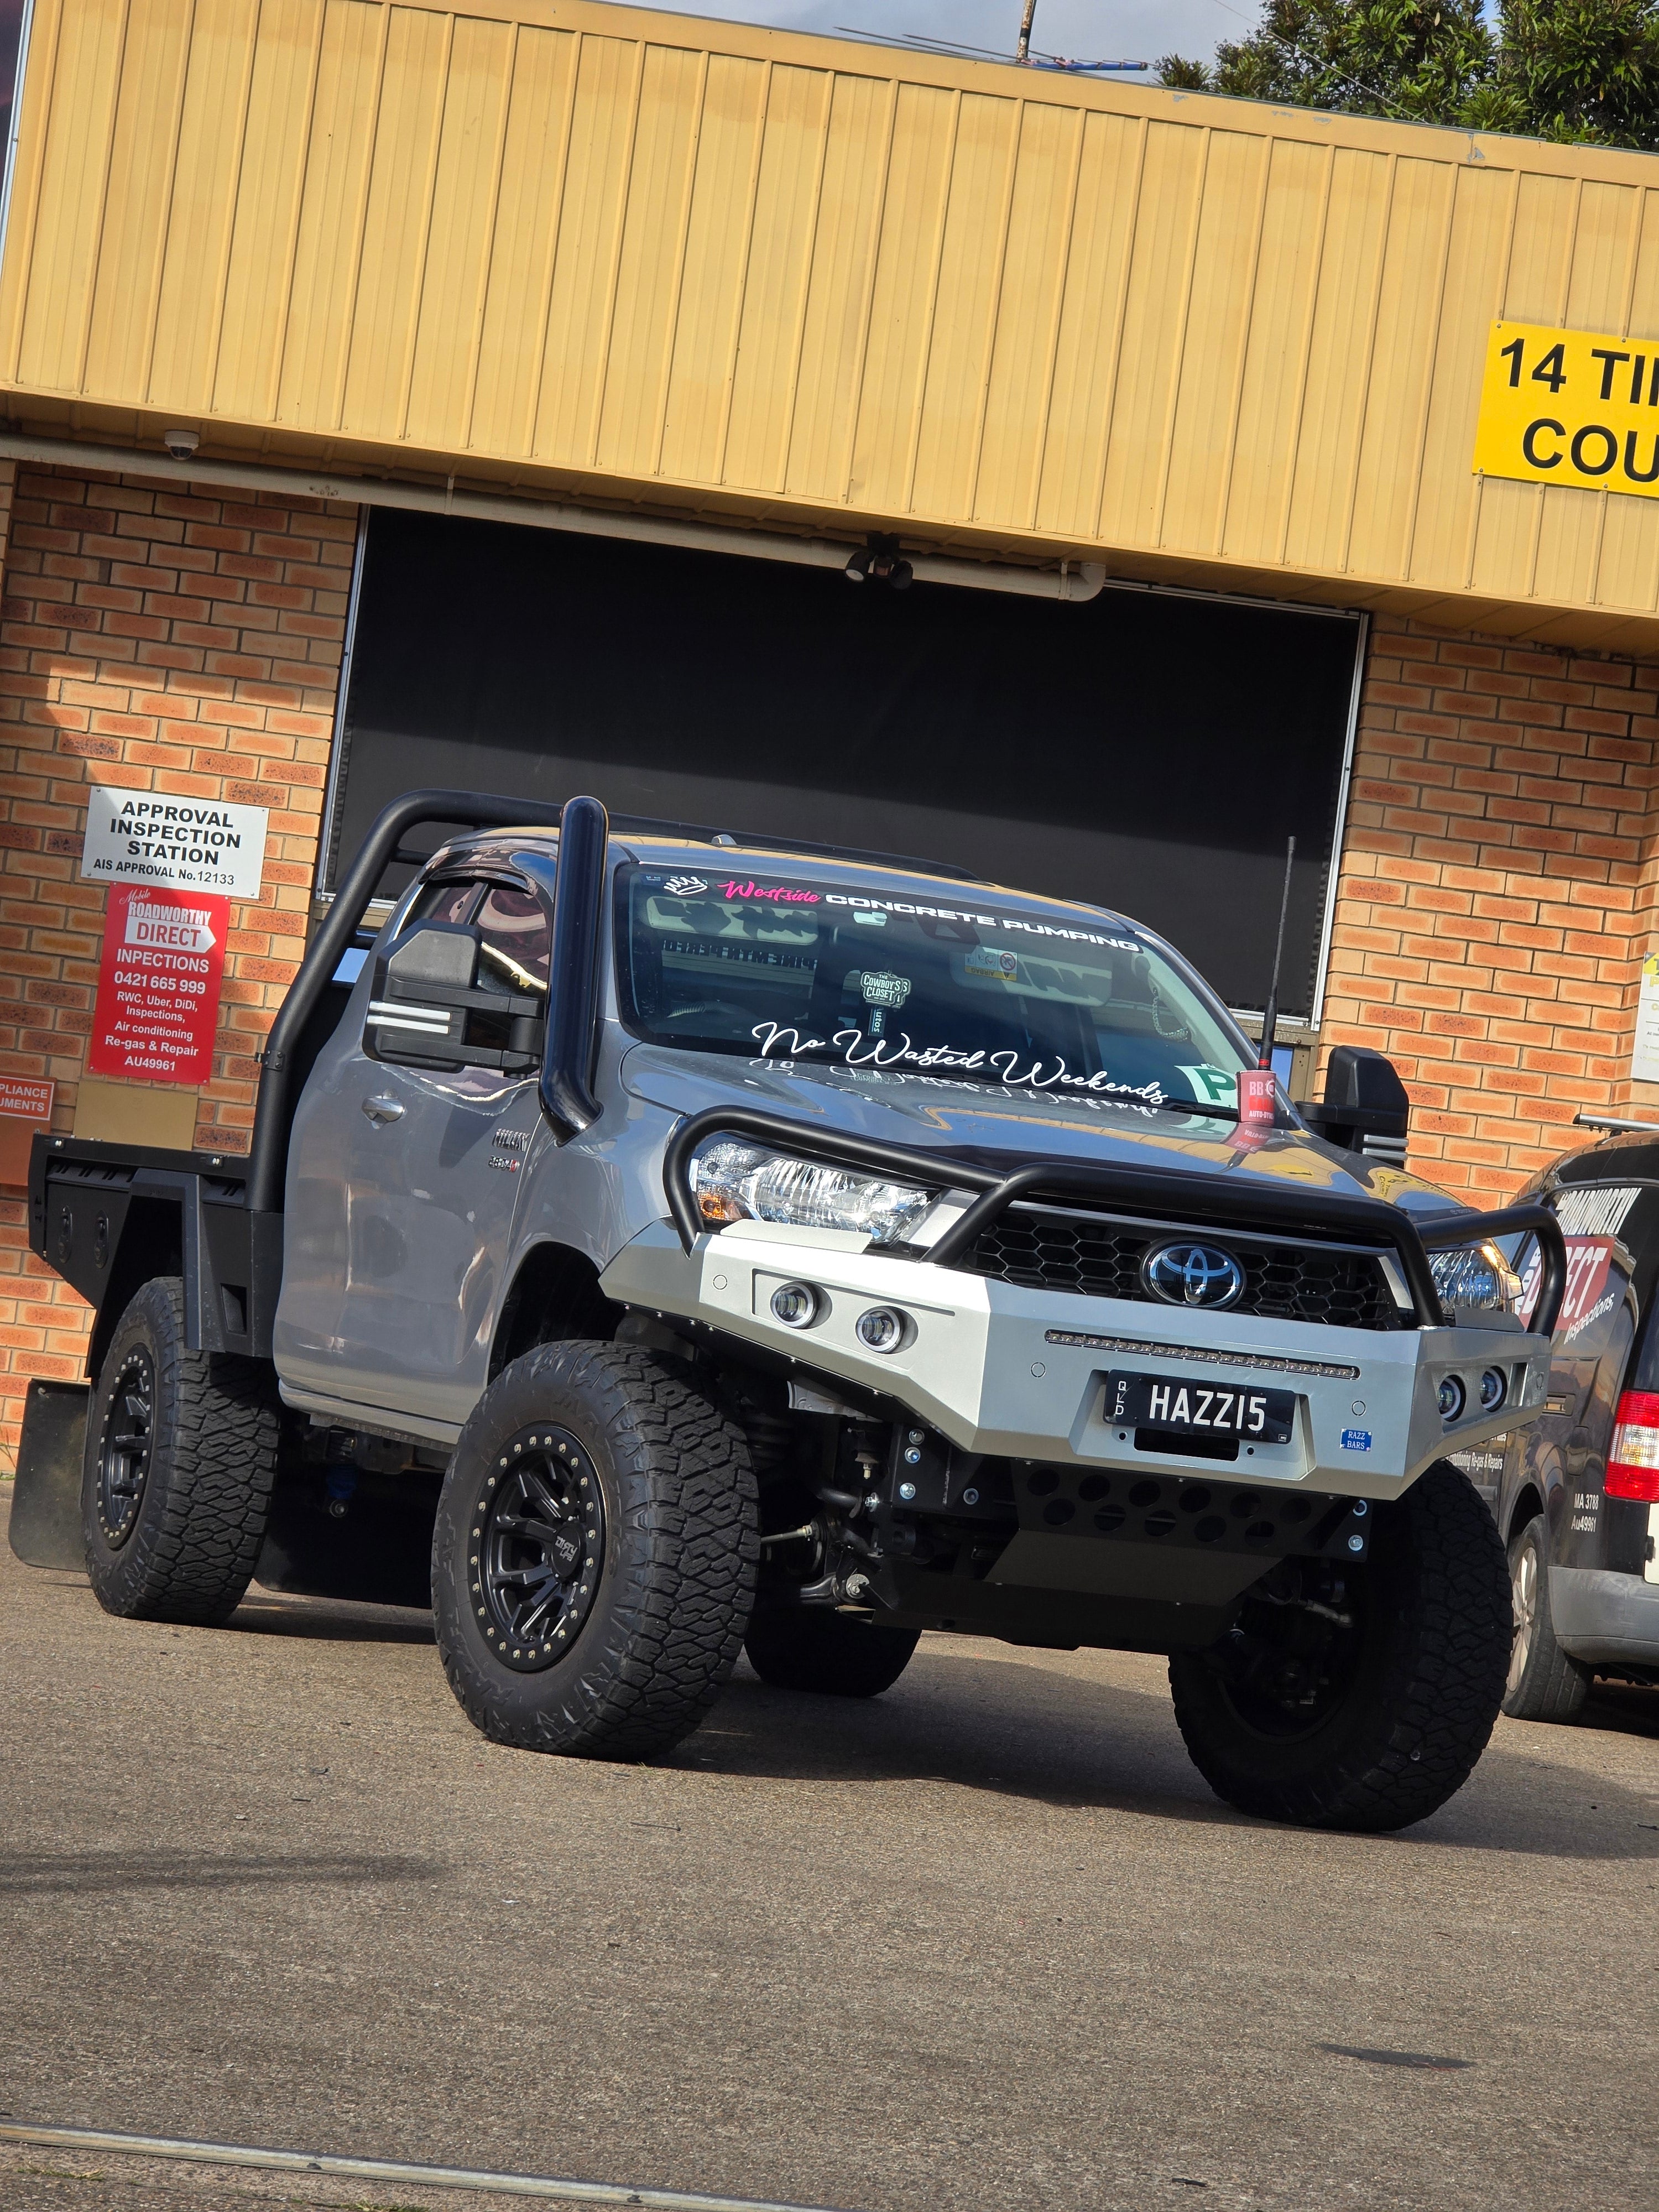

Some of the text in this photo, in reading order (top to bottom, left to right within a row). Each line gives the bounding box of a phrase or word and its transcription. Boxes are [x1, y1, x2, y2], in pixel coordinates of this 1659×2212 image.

[1500, 337, 1567, 393] 14
[121, 801, 234, 828] APPROVAL
[110, 818, 241, 849] INSPECTION
[127, 840, 220, 865] STATION
[93, 858, 113, 870] AIS
[115, 860, 175, 878] APPROVAL
[119, 888, 151, 905] Mobile
[128, 901, 212, 926] ROADWORTHY
[717, 880, 1140, 952] Westside CONCRETE PUMPING
[137, 921, 201, 947] DIRECT
[117, 948, 210, 973] INPECTIONS
[114, 971, 206, 994] 0421 665 999
[863, 974, 901, 991] COWBOY'S
[117, 991, 198, 1012] RWC, Uber, DiDi,
[866, 986, 895, 1001] CLOSET
[126, 1005, 186, 1023] Inspections,
[114, 1021, 194, 1042] Air conditioning
[105, 1035, 199, 1056] Re-gas & Repair
[124, 1055, 176, 1071] AU49961
[752, 1021, 826, 1057] No
[832, 1029, 985, 1069] Wasted
[989, 1051, 1169, 1105] Weekends
[1192, 1068, 1237, 1101] P
[1347, 1440, 1365, 1449] BARS
[1348, 1431, 1366, 1440] RAZZ
[1484, 1453, 1488, 1468] &
[1574, 1493, 1599, 1510] MA 3788
[1571, 1515, 1597, 1532] Au49961
